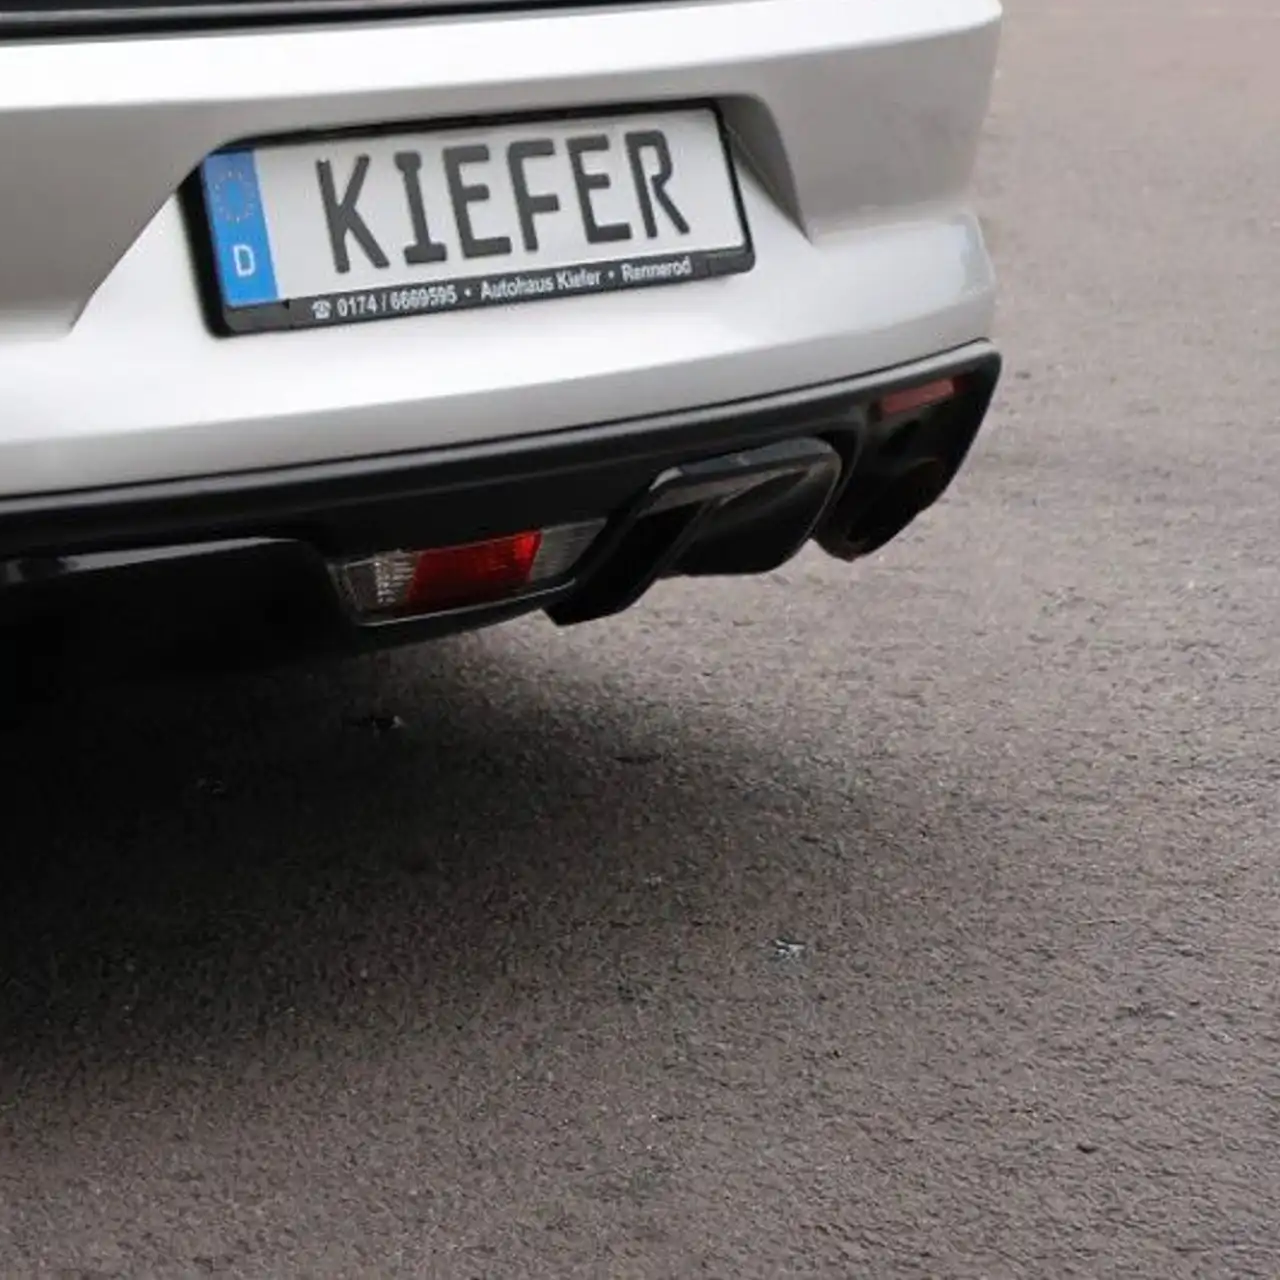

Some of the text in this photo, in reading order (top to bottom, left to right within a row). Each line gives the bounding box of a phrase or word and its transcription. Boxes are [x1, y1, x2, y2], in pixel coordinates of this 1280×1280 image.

[315, 129, 689, 273] KIEFER
[234, 244, 256, 277] D
[336, 294, 377, 317] 0174
[481, 276, 554, 300] Autohaus
[555, 271, 601, 289] Kiefer
[621, 256, 692, 281] Rennerod
